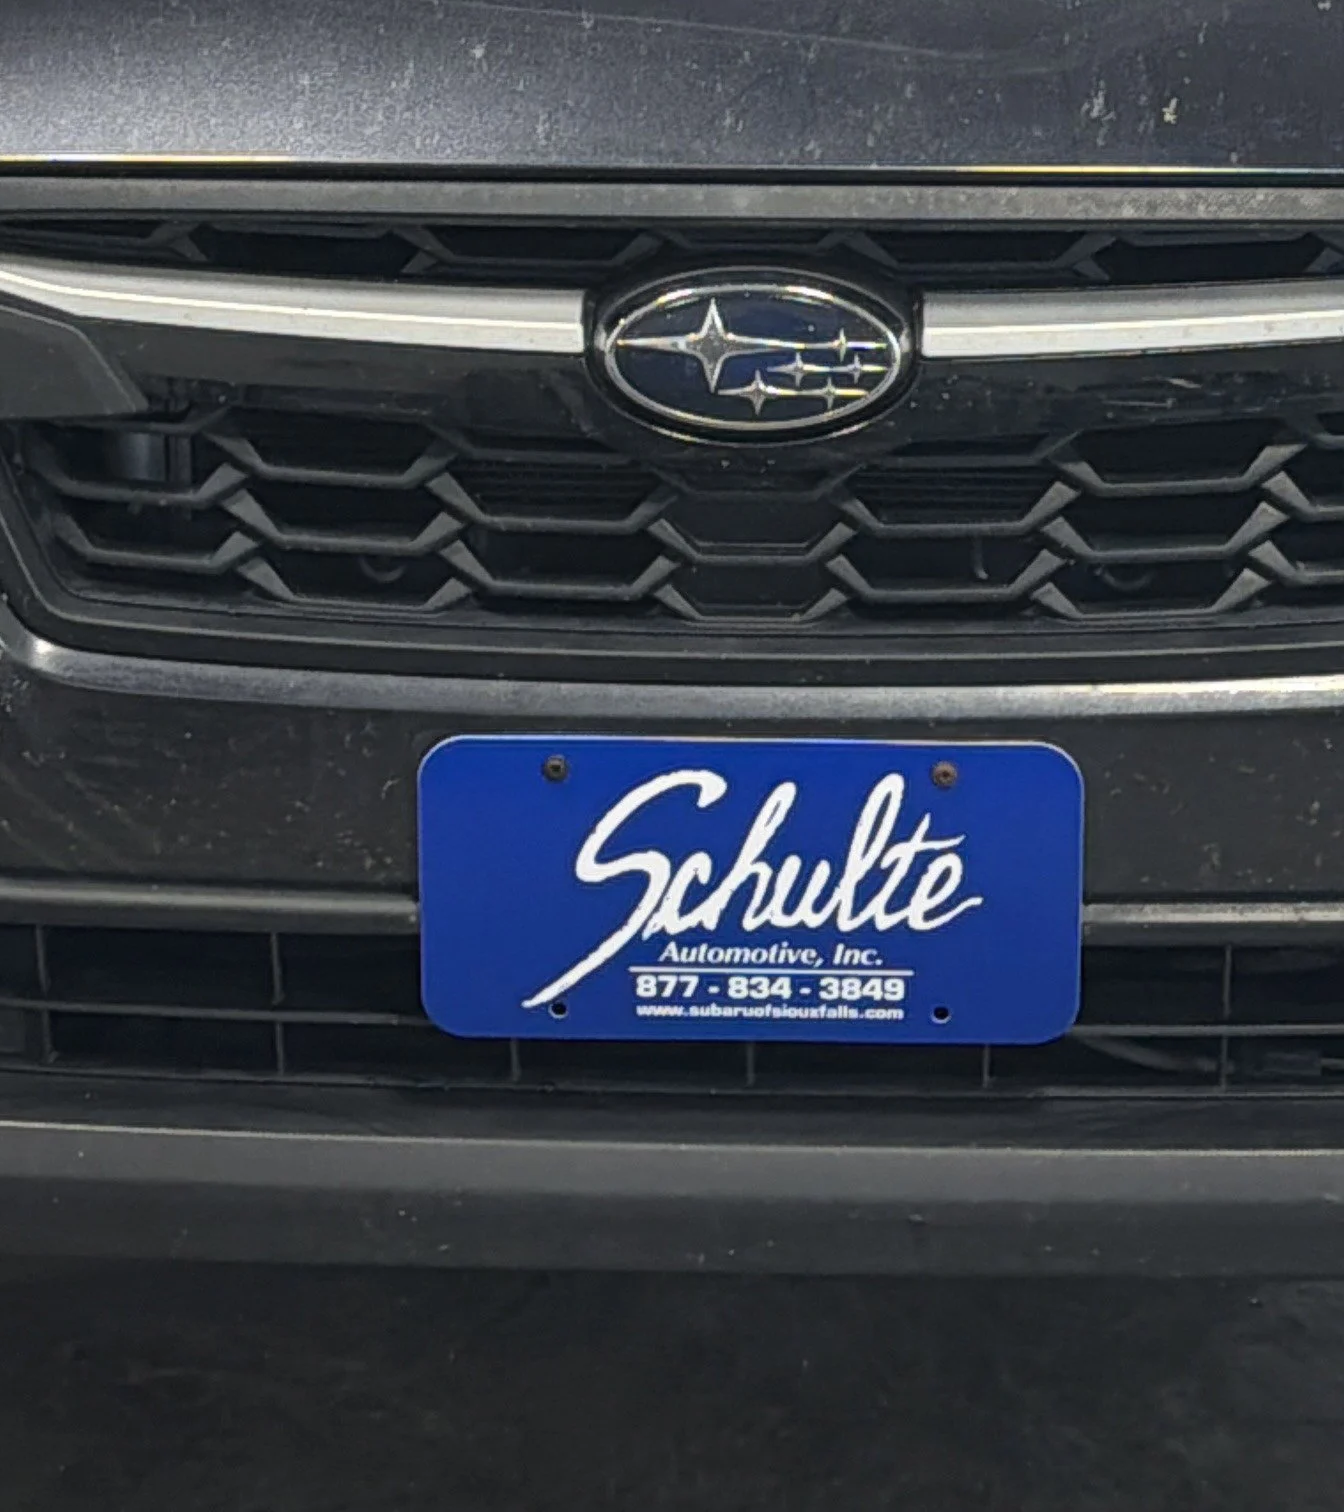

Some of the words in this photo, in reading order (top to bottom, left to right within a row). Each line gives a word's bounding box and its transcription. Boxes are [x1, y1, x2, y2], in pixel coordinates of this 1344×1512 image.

[521, 768, 983, 1009] Schulte
[657, 940, 824, 968] Automotive,
[832, 943, 884, 966] Inc.
[635, 974, 699, 998] 877
[727, 975, 792, 1000] 834
[818, 976, 906, 1001] 3849
[635, 1003, 905, 1021] www.subaruofsiouxfalls.com
